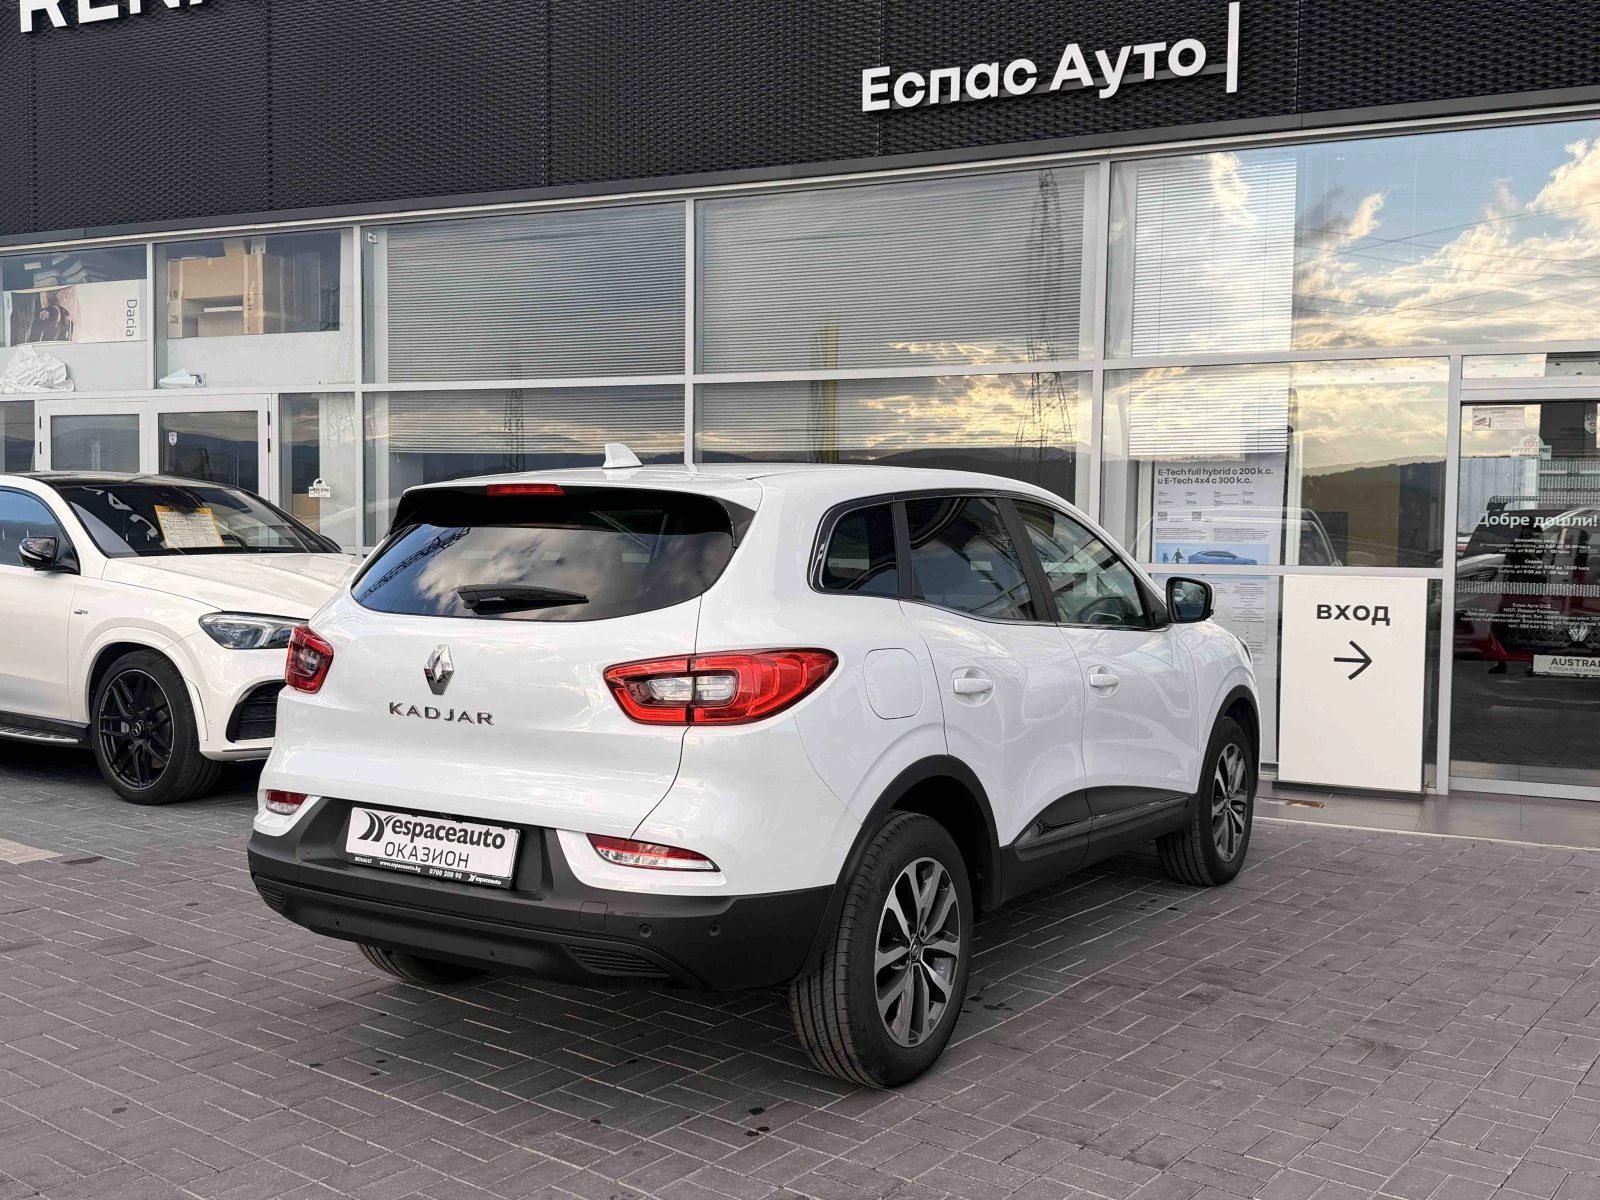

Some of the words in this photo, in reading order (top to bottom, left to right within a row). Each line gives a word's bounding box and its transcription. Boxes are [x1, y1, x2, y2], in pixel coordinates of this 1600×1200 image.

[862, 58, 1037, 112] Еспас
[1050, 38, 1206, 99] Ауто
[126, 299, 138, 338] Dacia
[1158, 468, 1187, 476] E-Tech
[1187, 468, 1201, 476] full
[1202, 467, 1231, 477] hybrid
[1239, 467, 1256, 475] 200
[1164, 477, 1193, 485] E-Tech
[1477, 512, 1530, 528] Добре
[1533, 514, 1598, 527] дошли!
[389, 701, 494, 726] KADJAR
[391, 817, 506, 850] espaceauto
[384, 841, 470, 869] ОКАЗИОН
